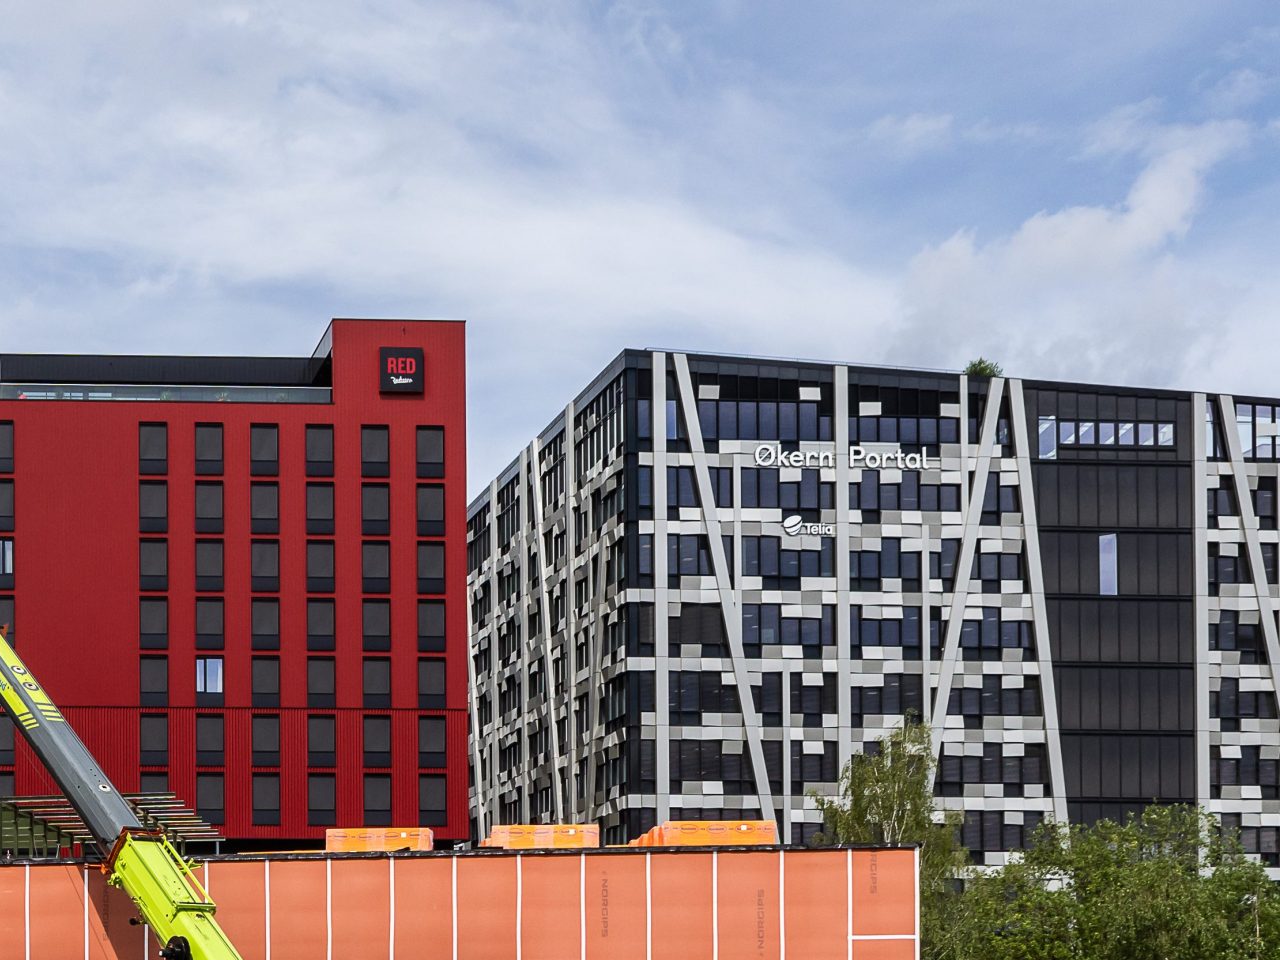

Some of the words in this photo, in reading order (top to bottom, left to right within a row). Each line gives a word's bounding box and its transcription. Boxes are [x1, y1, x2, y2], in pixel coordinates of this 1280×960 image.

[387, 357, 416, 374] RED
[754, 444, 833, 468] Økern
[849, 446, 929, 469] Portal
[805, 522, 833, 535] Telia
